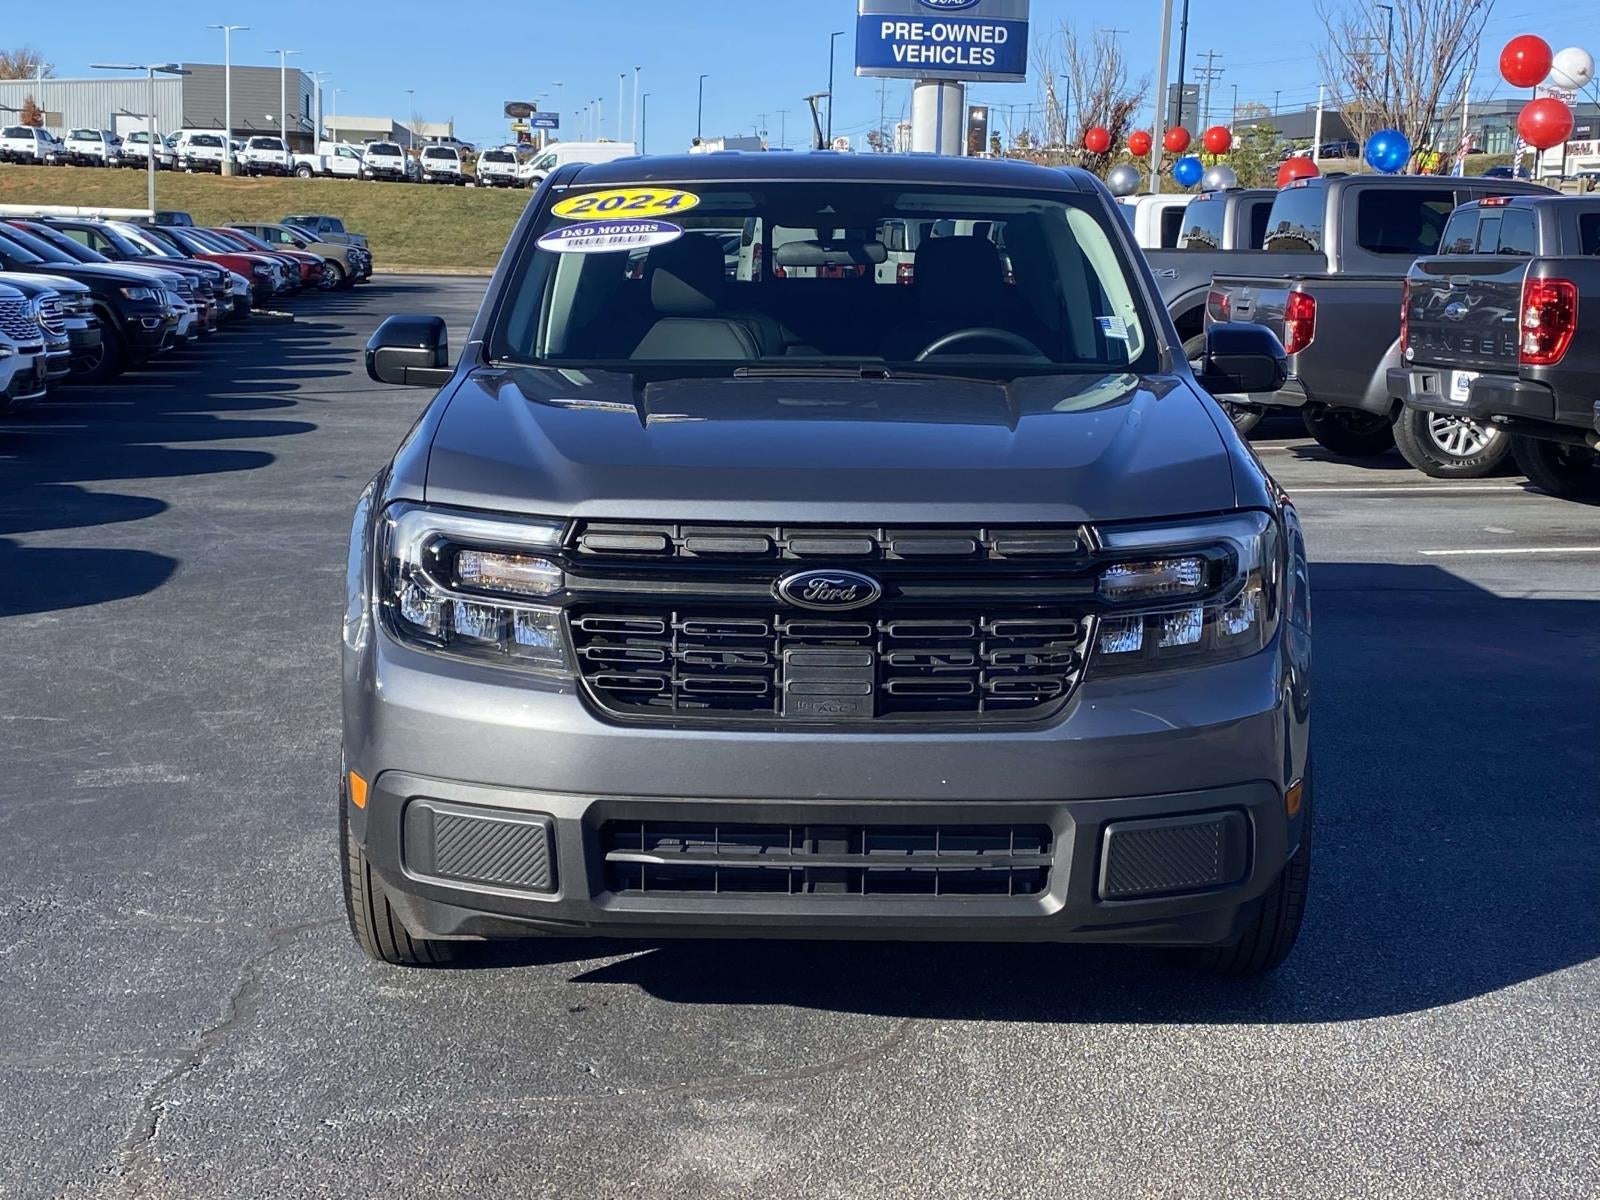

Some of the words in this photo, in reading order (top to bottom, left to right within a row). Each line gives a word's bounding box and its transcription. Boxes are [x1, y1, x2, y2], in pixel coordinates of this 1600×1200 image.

[881, 22, 1008, 44] PRE-OWNED
[892, 44, 996, 66] VEHICLES
[565, 194, 686, 214] 2024
[560, 227, 595, 238] D&D
[597, 224, 659, 235] MOTORS
[566, 236, 605, 247] TRUE
[608, 234, 650, 245] BLUE
[803, 577, 857, 601] Ford
